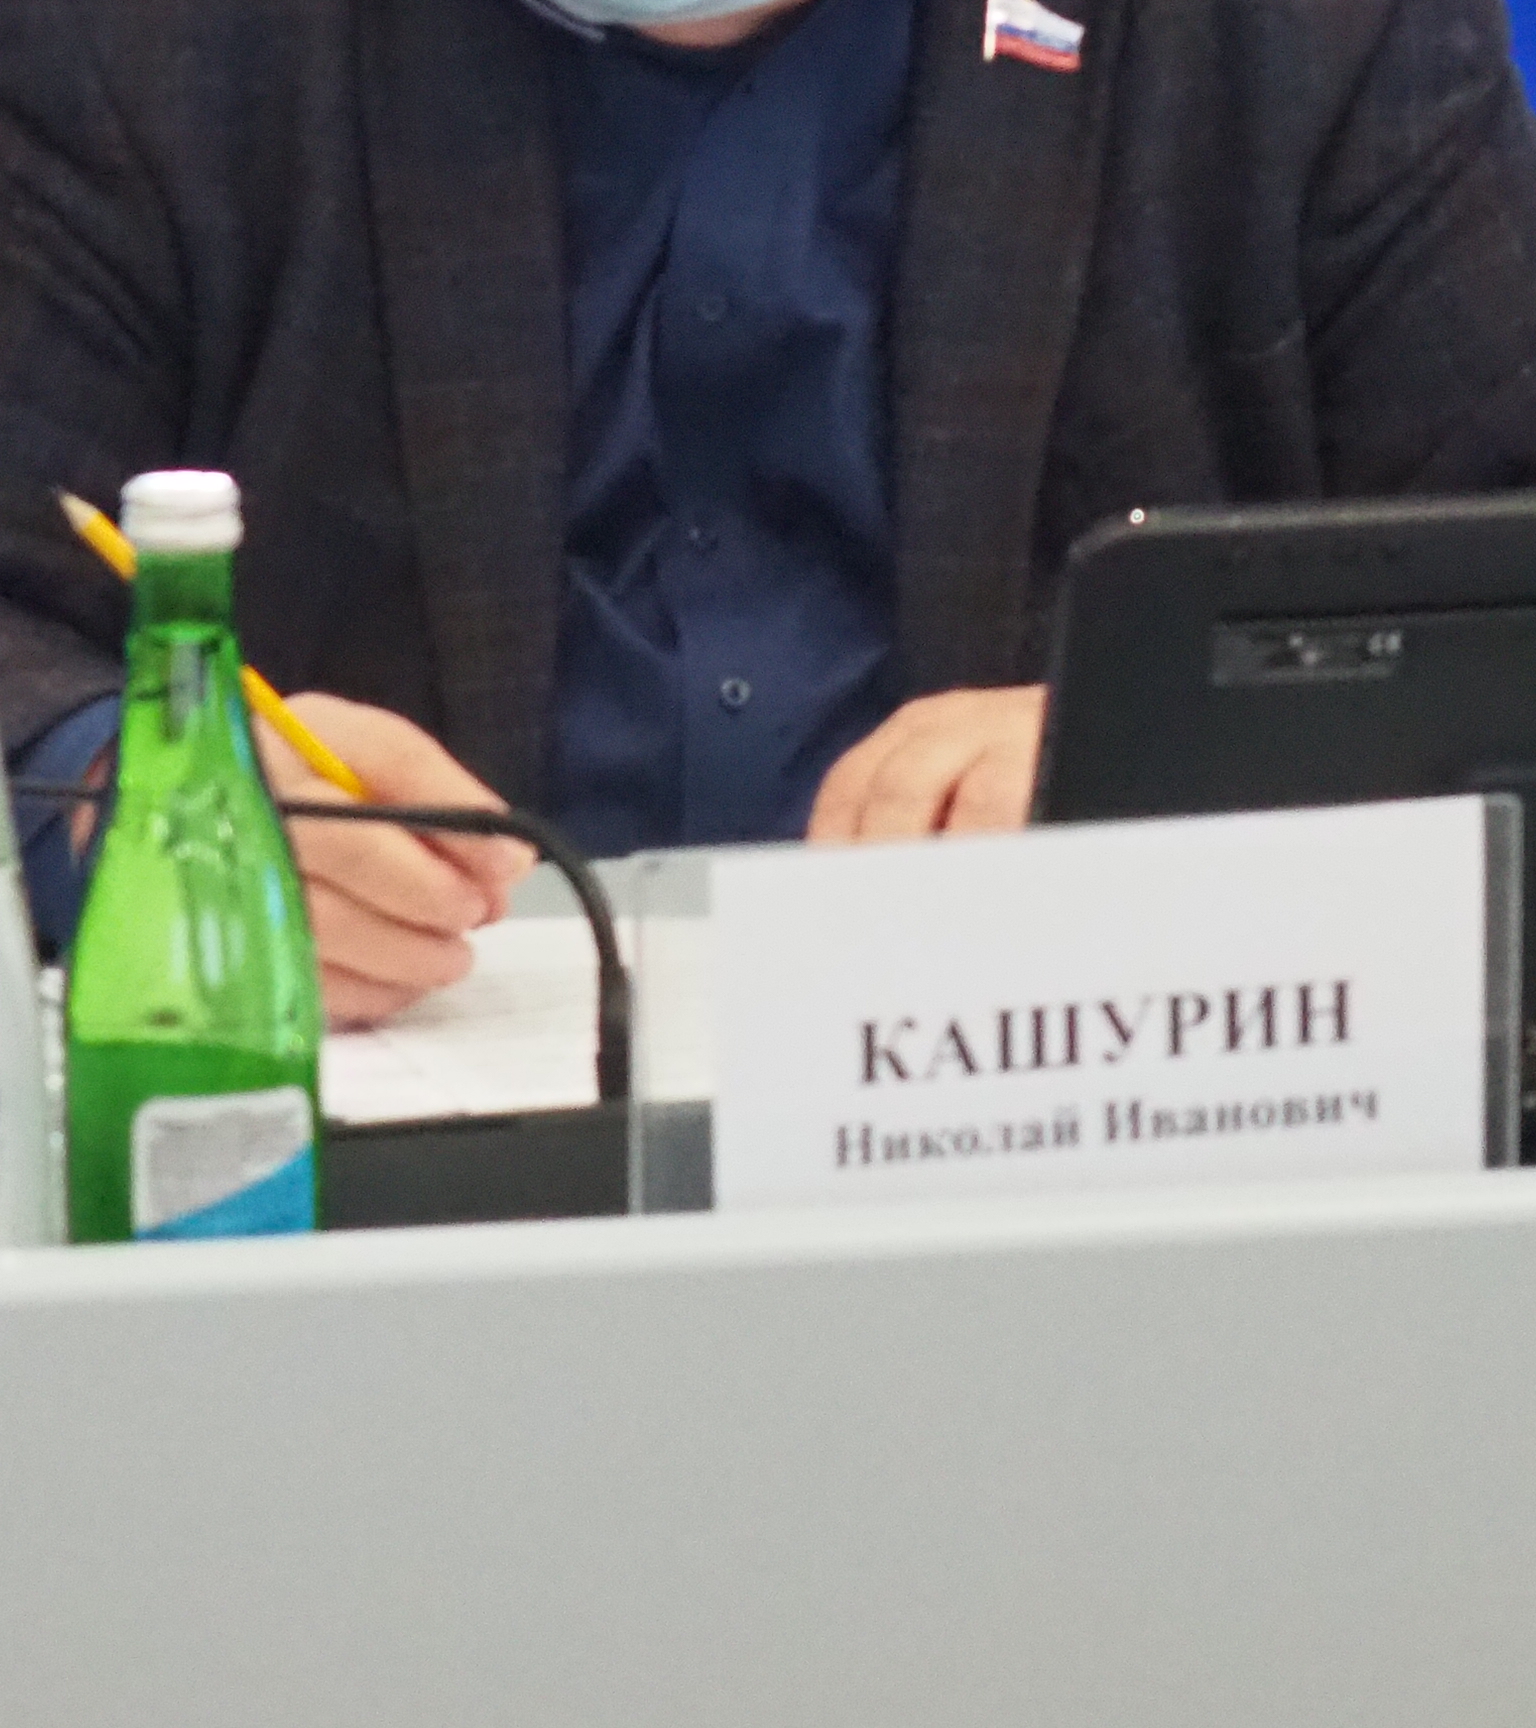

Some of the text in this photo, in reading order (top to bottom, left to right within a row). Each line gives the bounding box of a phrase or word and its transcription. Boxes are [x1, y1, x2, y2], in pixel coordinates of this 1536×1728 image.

[857, 980, 1352, 1085] КАШУРИН
[835, 1090, 1379, 1168] Николай Иванович
